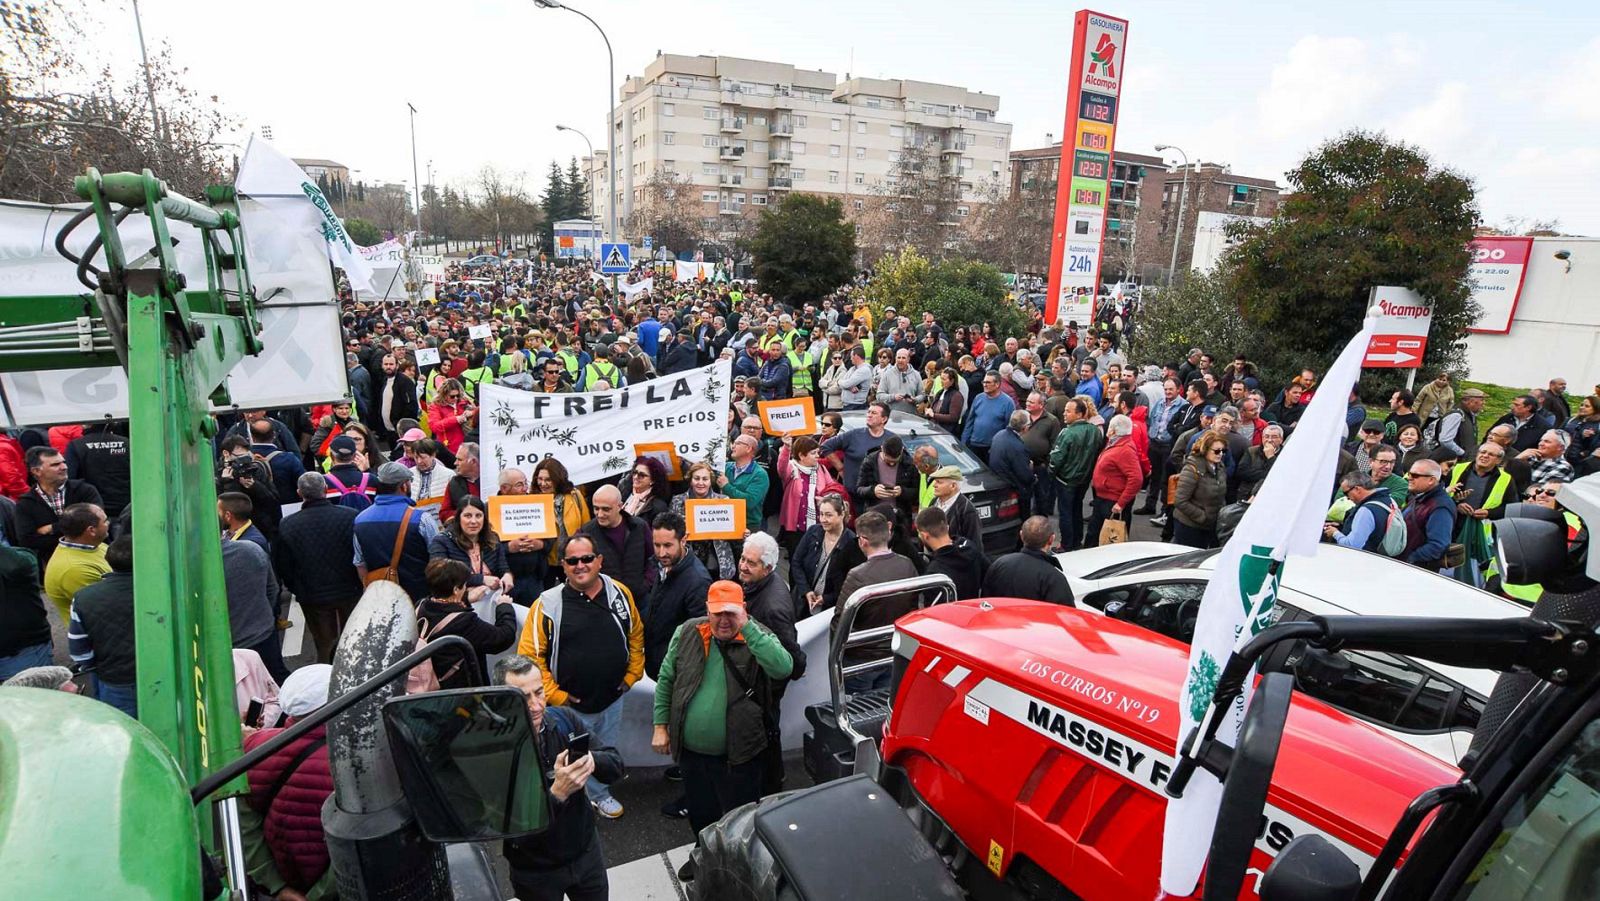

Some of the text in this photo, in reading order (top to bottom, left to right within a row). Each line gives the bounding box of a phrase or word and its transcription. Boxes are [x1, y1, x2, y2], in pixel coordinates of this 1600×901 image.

[1090, 17, 1123, 32] GASOLINERA
[1085, 74, 1117, 90] Alcampo
[1069, 255, 1092, 272] 24h
[770, 410, 801, 420] FREILA
[577, 439, 626, 456] UNOS
[675, 442, 700, 454] OS
[1020, 658, 1051, 678] LOS
[1050, 670, 1118, 705] CURROS
[1027, 700, 1146, 774] MASSEY
[1149, 759, 1172, 787] F
